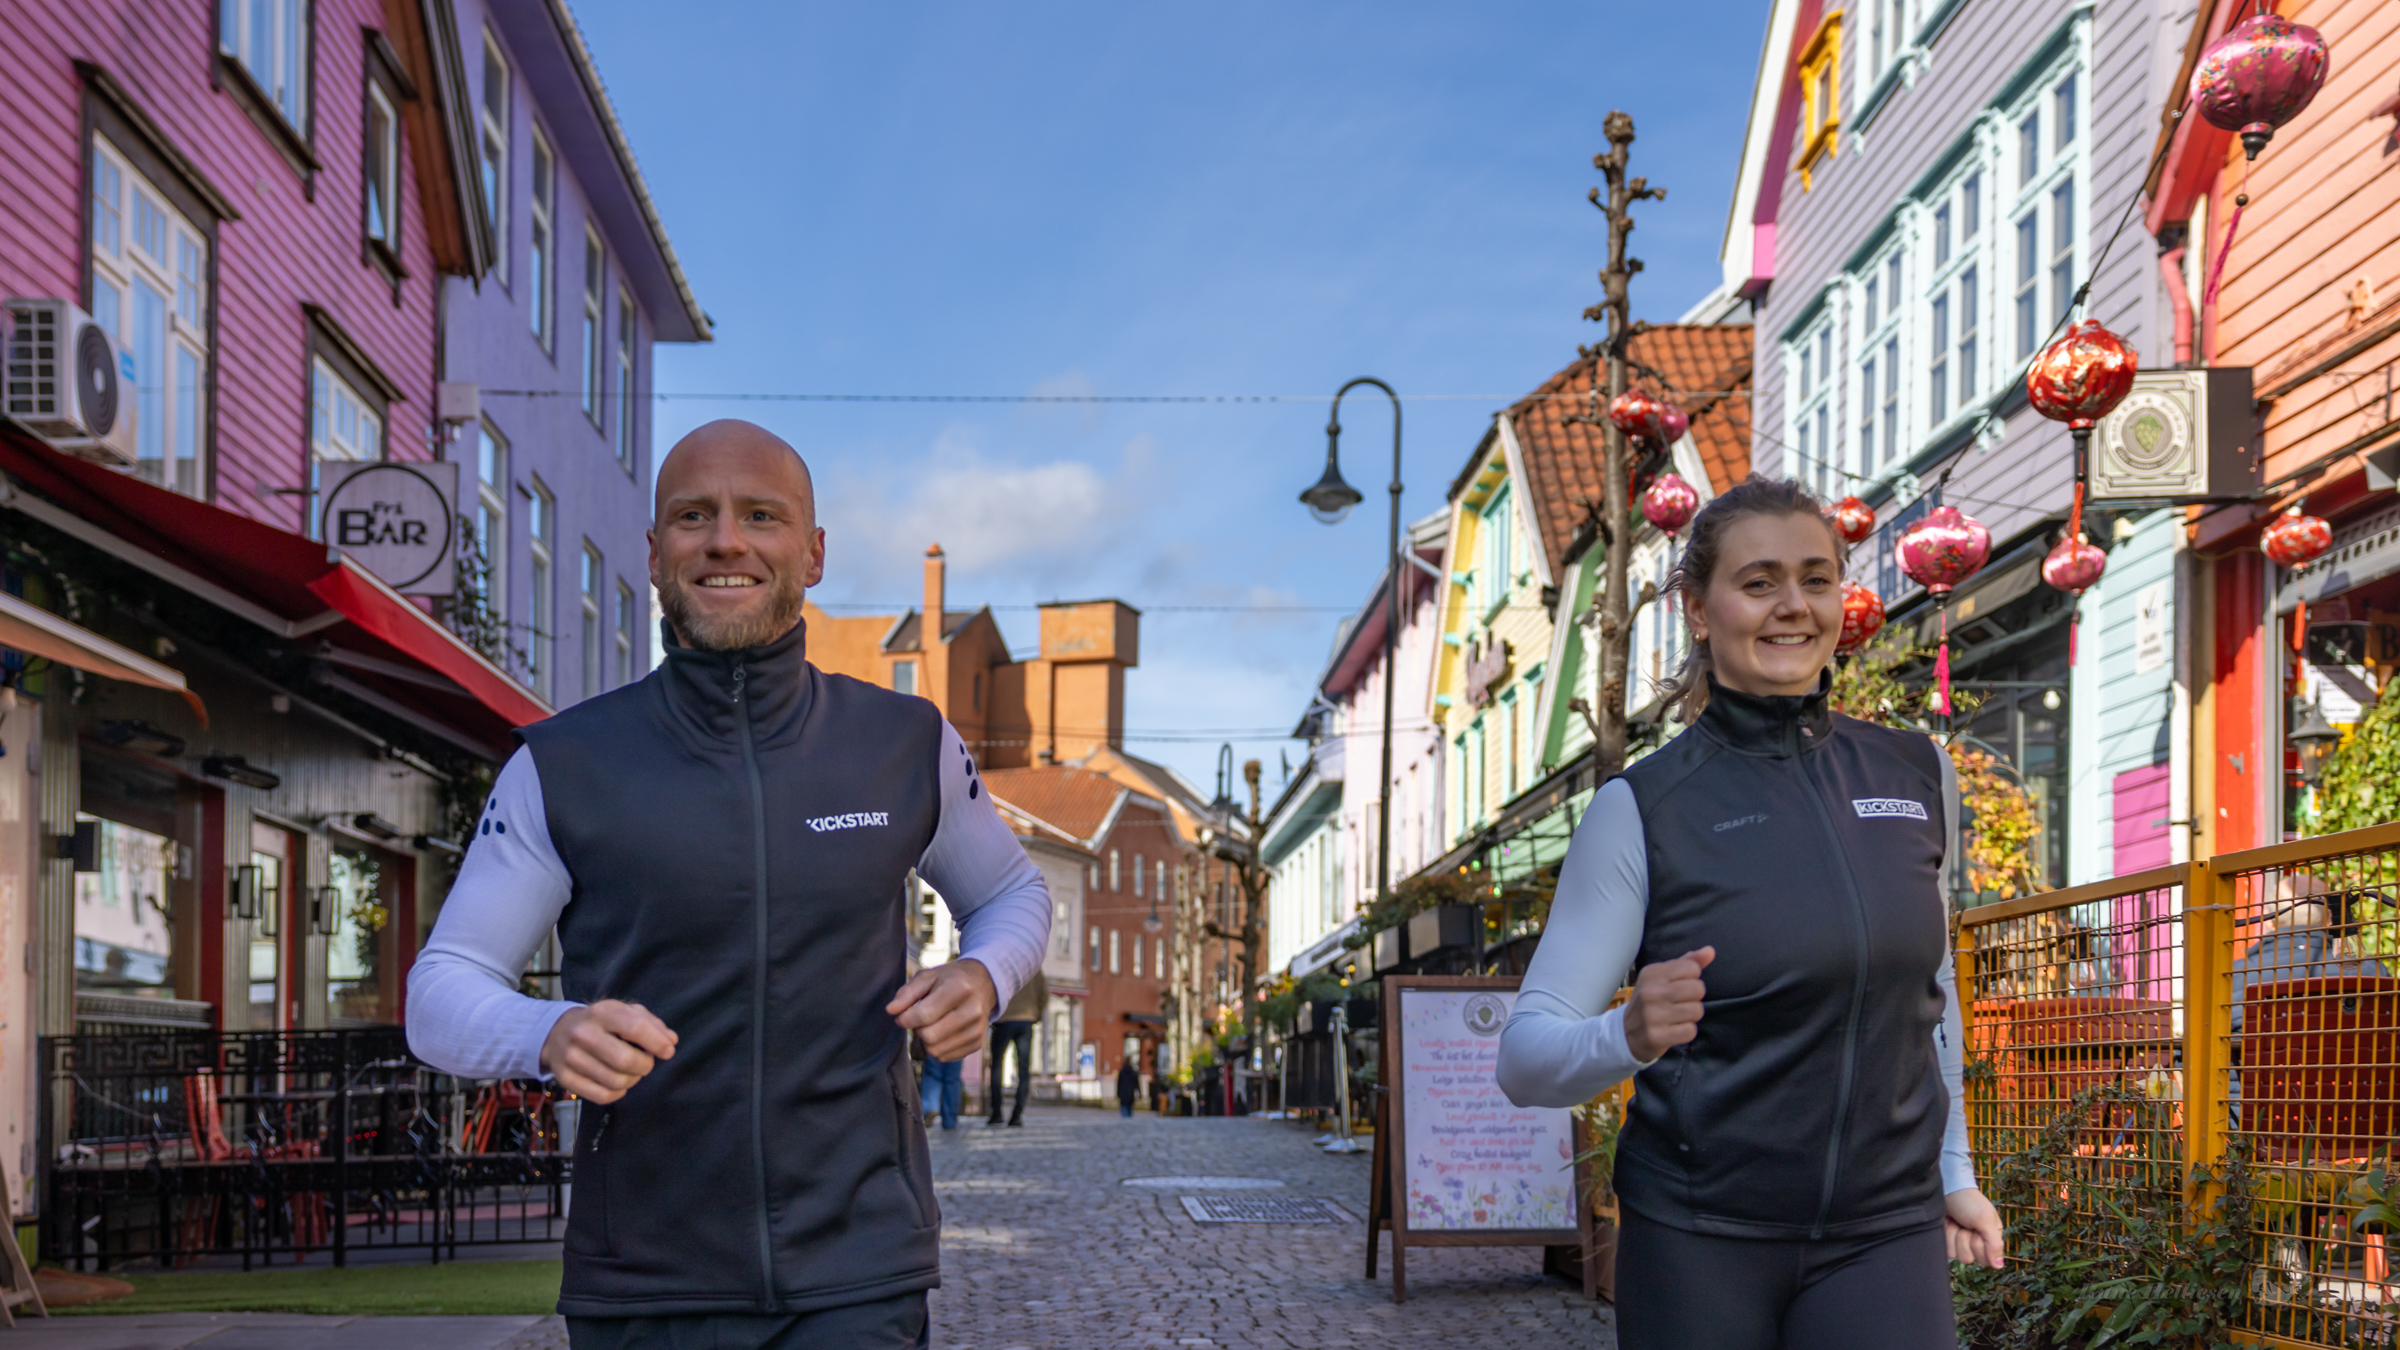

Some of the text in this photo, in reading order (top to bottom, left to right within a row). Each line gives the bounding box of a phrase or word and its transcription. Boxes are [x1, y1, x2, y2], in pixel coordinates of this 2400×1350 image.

[372, 502, 404, 515] Fri
[338, 509, 428, 545] BAR
[1858, 801, 1925, 816] KICKSTART
[806, 811, 889, 832] KICKSTART
[1712, 814, 1756, 833] CRAFT
